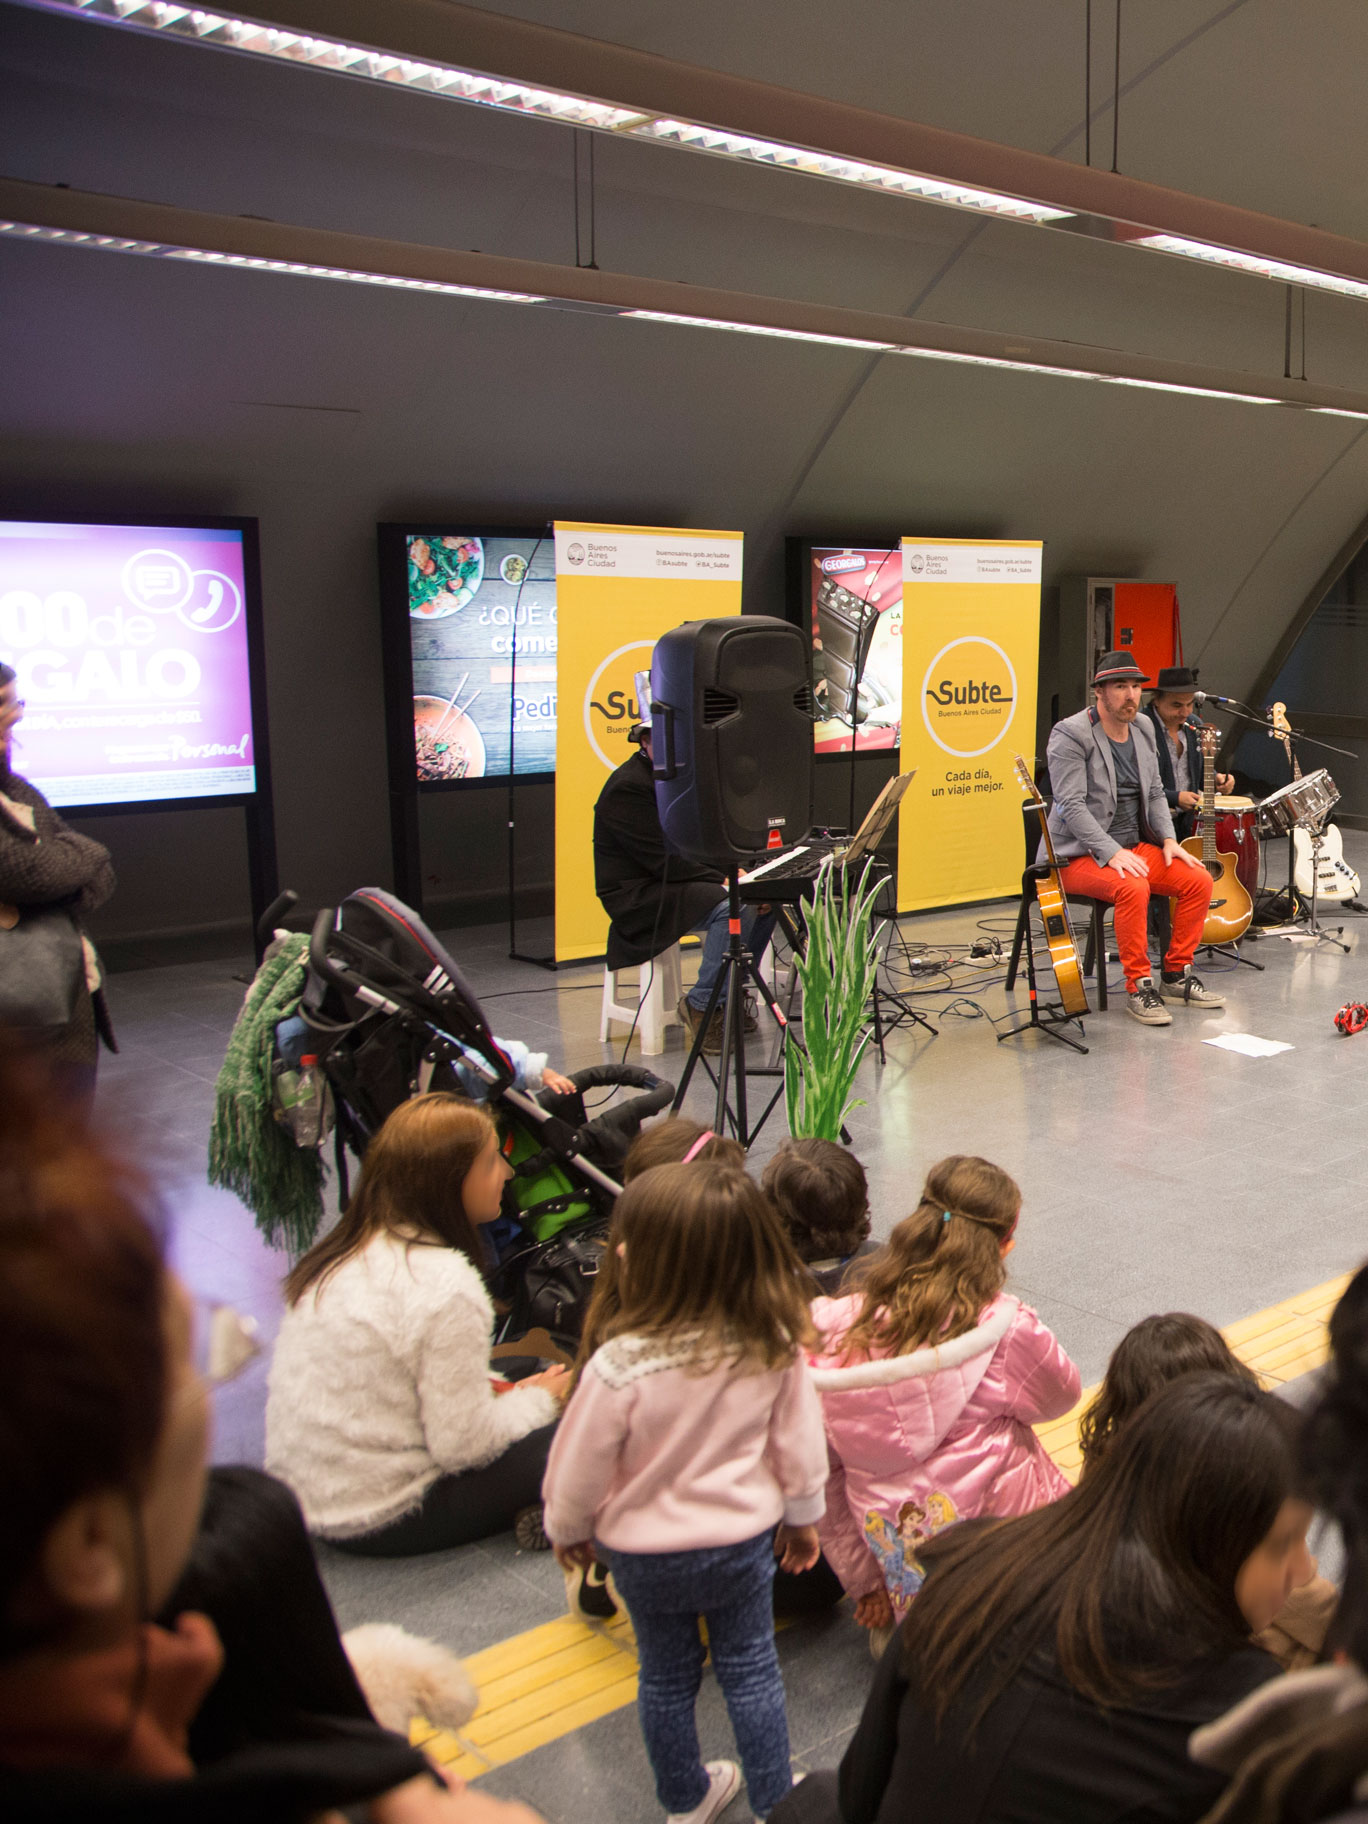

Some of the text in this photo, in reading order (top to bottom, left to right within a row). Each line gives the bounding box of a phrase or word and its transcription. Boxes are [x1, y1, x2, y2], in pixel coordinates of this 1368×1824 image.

[588, 543, 617, 552] Buenos
[588, 560, 616, 568] Ciudad
[824, 558, 864, 571] GEORGALOS
[479, 602, 542, 626] ¿QUÉ
[89, 605, 157, 647] de
[890, 624, 903, 636] C
[927, 680, 1012, 705] Subte
[168, 733, 249, 761] Personal
[946, 769, 992, 782] Cada día,
[932, 782, 1004, 796] un viaje mejor.
